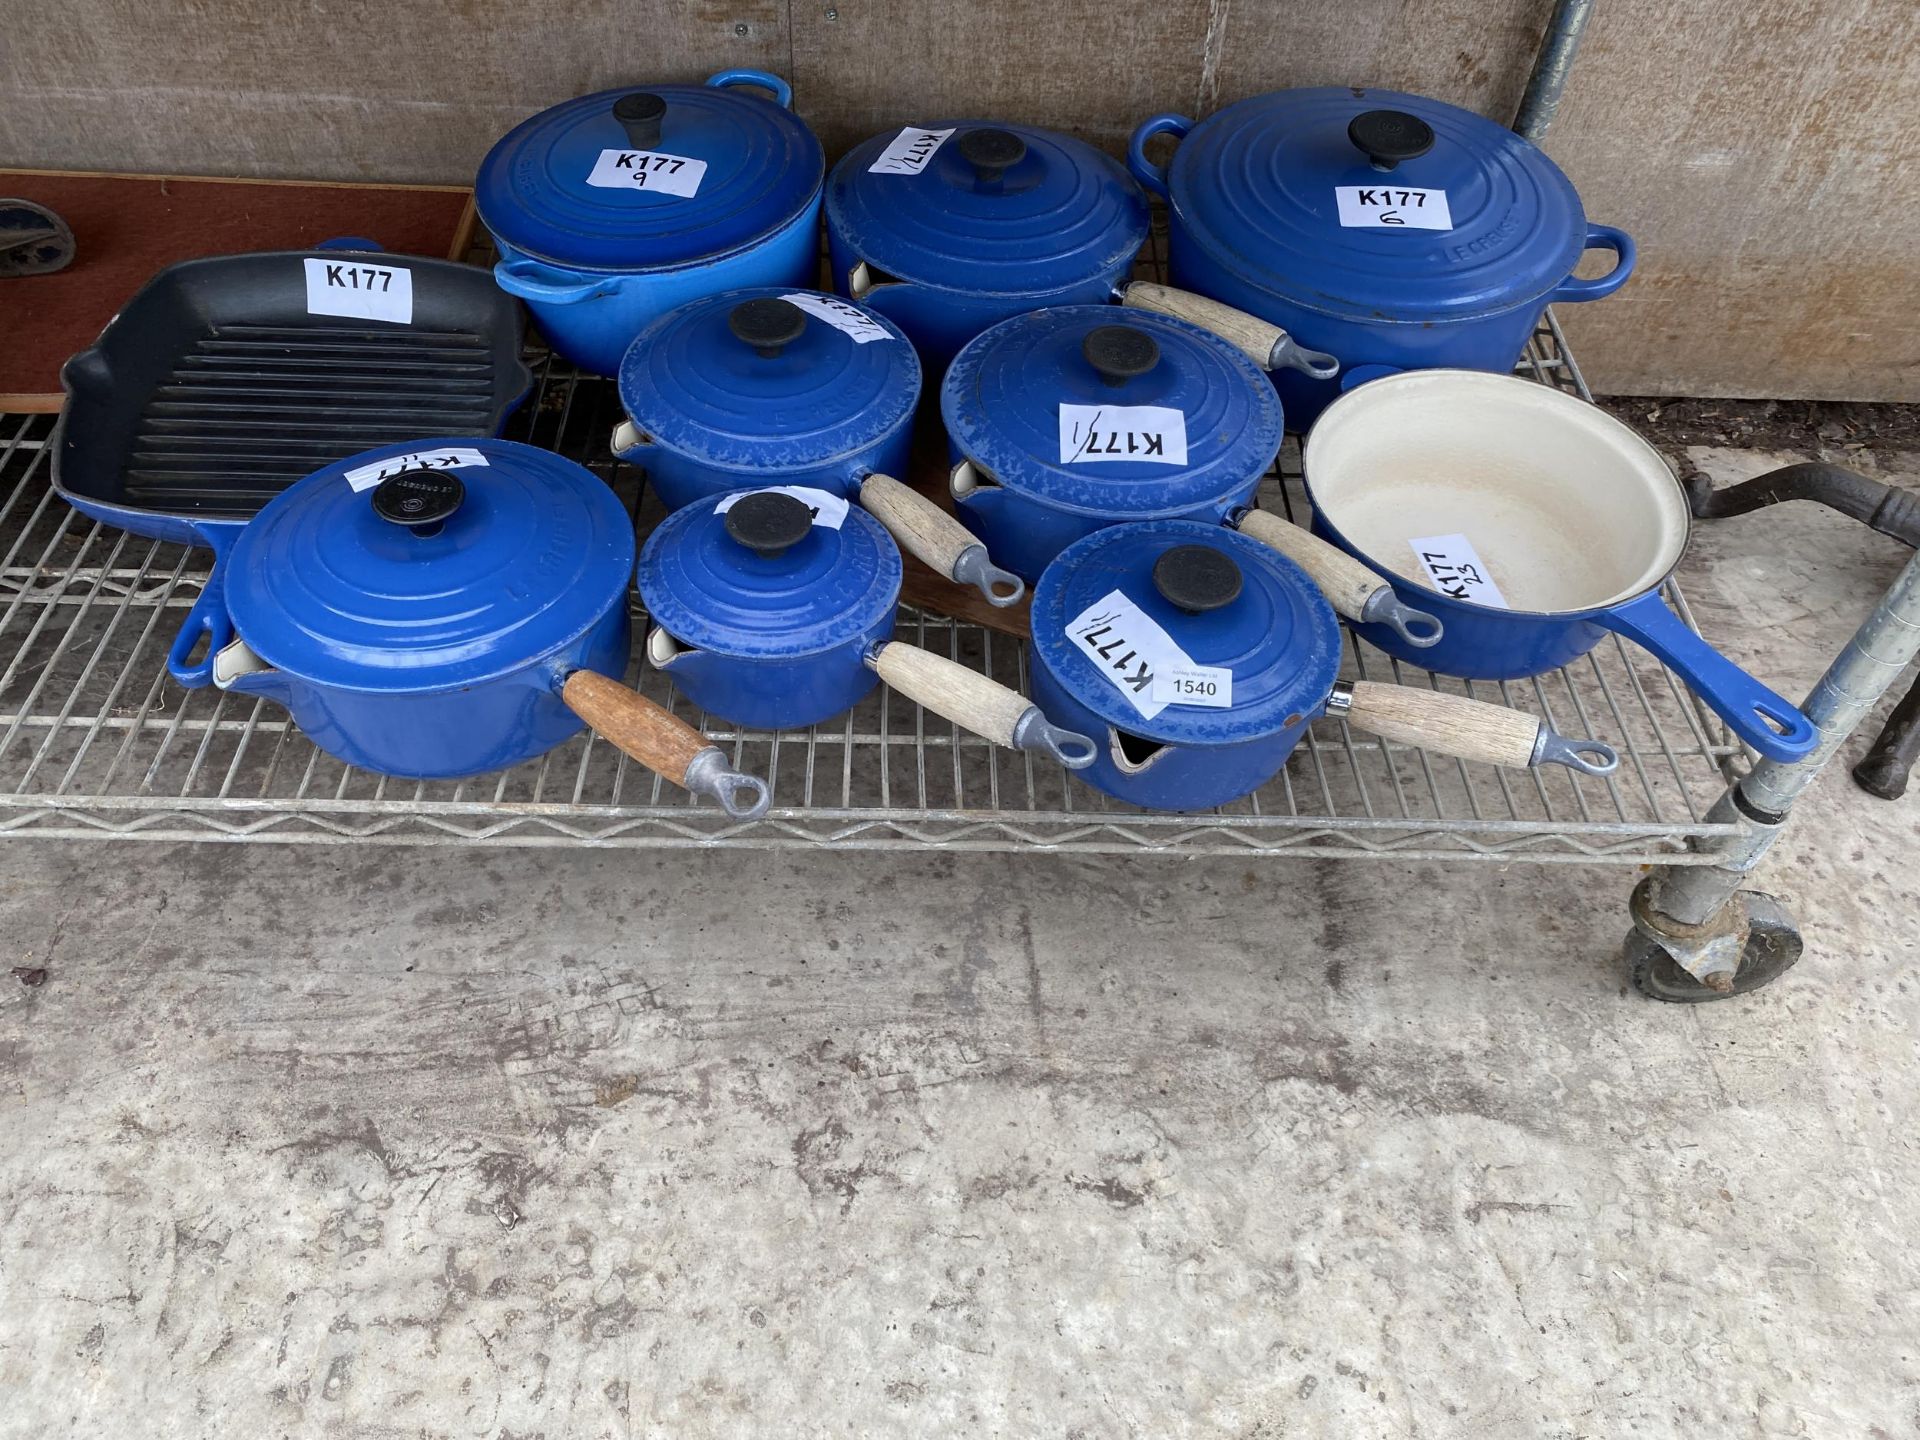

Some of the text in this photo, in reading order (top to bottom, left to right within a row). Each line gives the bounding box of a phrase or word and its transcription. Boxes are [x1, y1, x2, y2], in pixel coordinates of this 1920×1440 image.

[616, 154, 685, 174] K177
[633, 172, 647, 186] 9
[1359, 190, 1426, 207] K177
[1380, 211, 1405, 224] 6
[1443, 244, 1471, 262] LE
[326, 265, 392, 292] K177
[1422, 552, 1470, 599] K177
[1457, 564, 1483, 584] 23
[1173, 680, 1216, 696] 1540
